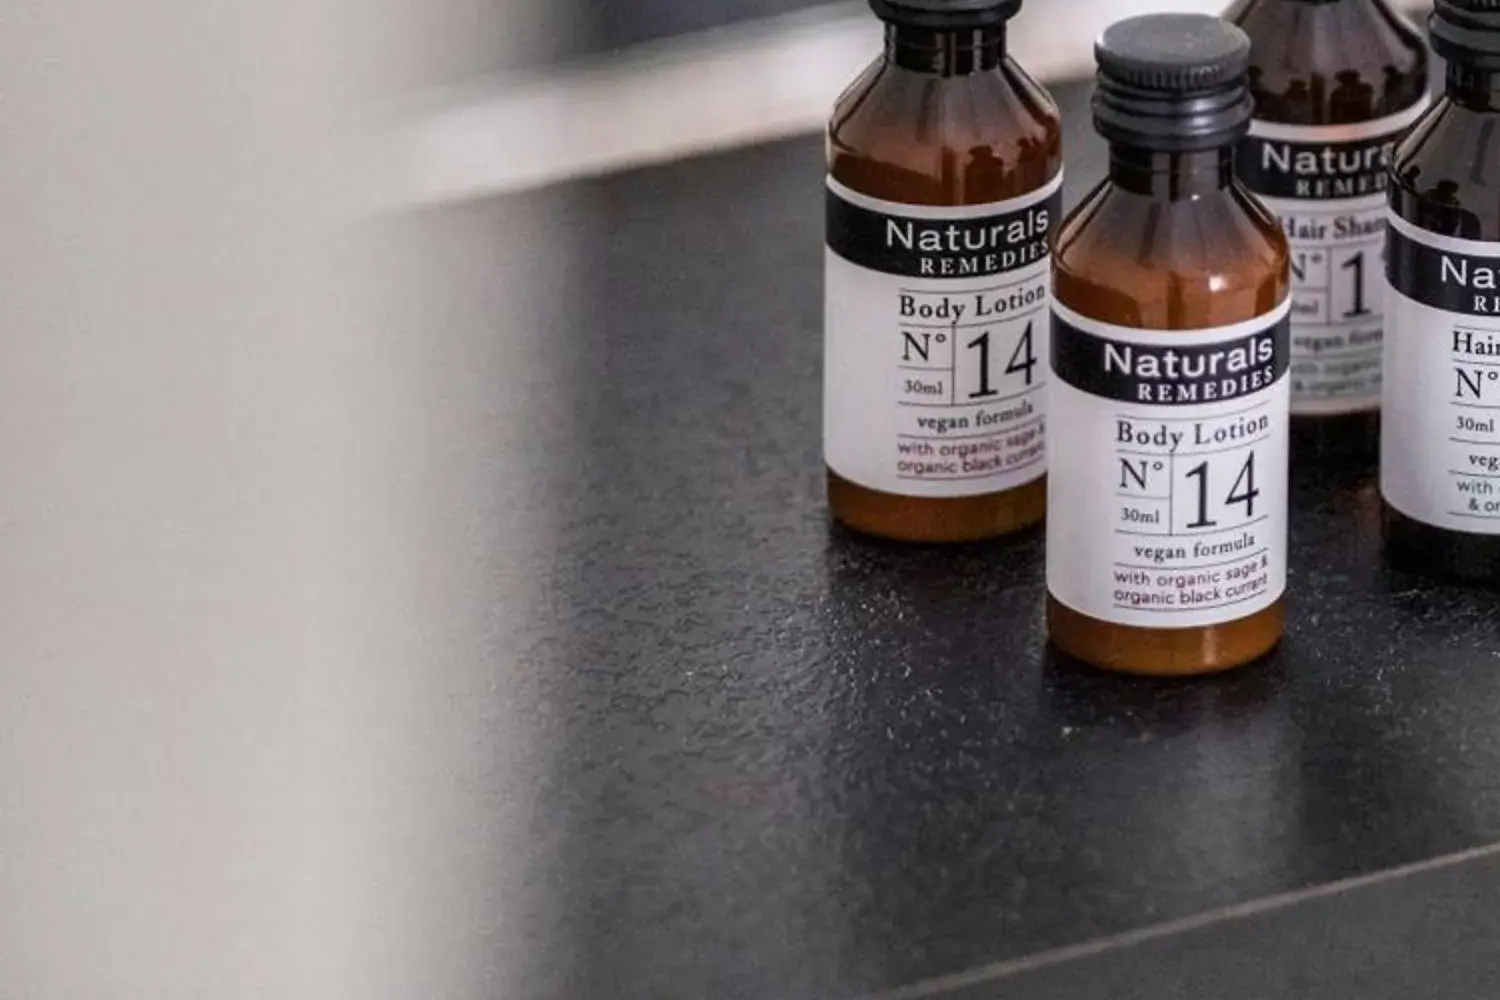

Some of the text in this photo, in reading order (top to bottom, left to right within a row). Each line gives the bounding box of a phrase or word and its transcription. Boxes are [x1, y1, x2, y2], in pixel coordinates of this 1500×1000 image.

[886, 208, 1049, 252] Naturals
[920, 236, 1049, 275] REMEDIES
[1341, 250, 1372, 318] 1
[899, 284, 1045, 325] Body Lotion
[901, 320, 1038, 399] N° 14
[1103, 336, 1273, 379] Naturals
[904, 379, 944, 396] 30ml
[1137, 366, 1273, 402] REMEDIES
[1455, 367, 1499, 400] N°
[917, 399, 1034, 433] vegan formula
[1455, 416, 1495, 433] 30ml
[897, 442, 933, 455] with
[939, 438, 1001, 459] organic
[1116, 414, 1269, 452] Body Lotion
[897, 459, 957, 475] organic
[962, 454, 1002, 473] black
[1118, 450, 1260, 529] N° 14
[1456, 480, 1493, 495] with
[1121, 508, 1160, 525] 30ml
[1468, 498, 1479, 511] &
[1134, 532, 1255, 563] vegan formula
[1113, 573, 1268, 606] organic black currant
[1114, 571, 1150, 586] with
[1156, 572, 1221, 588] organic
[1225, 562, 1257, 581] sage
